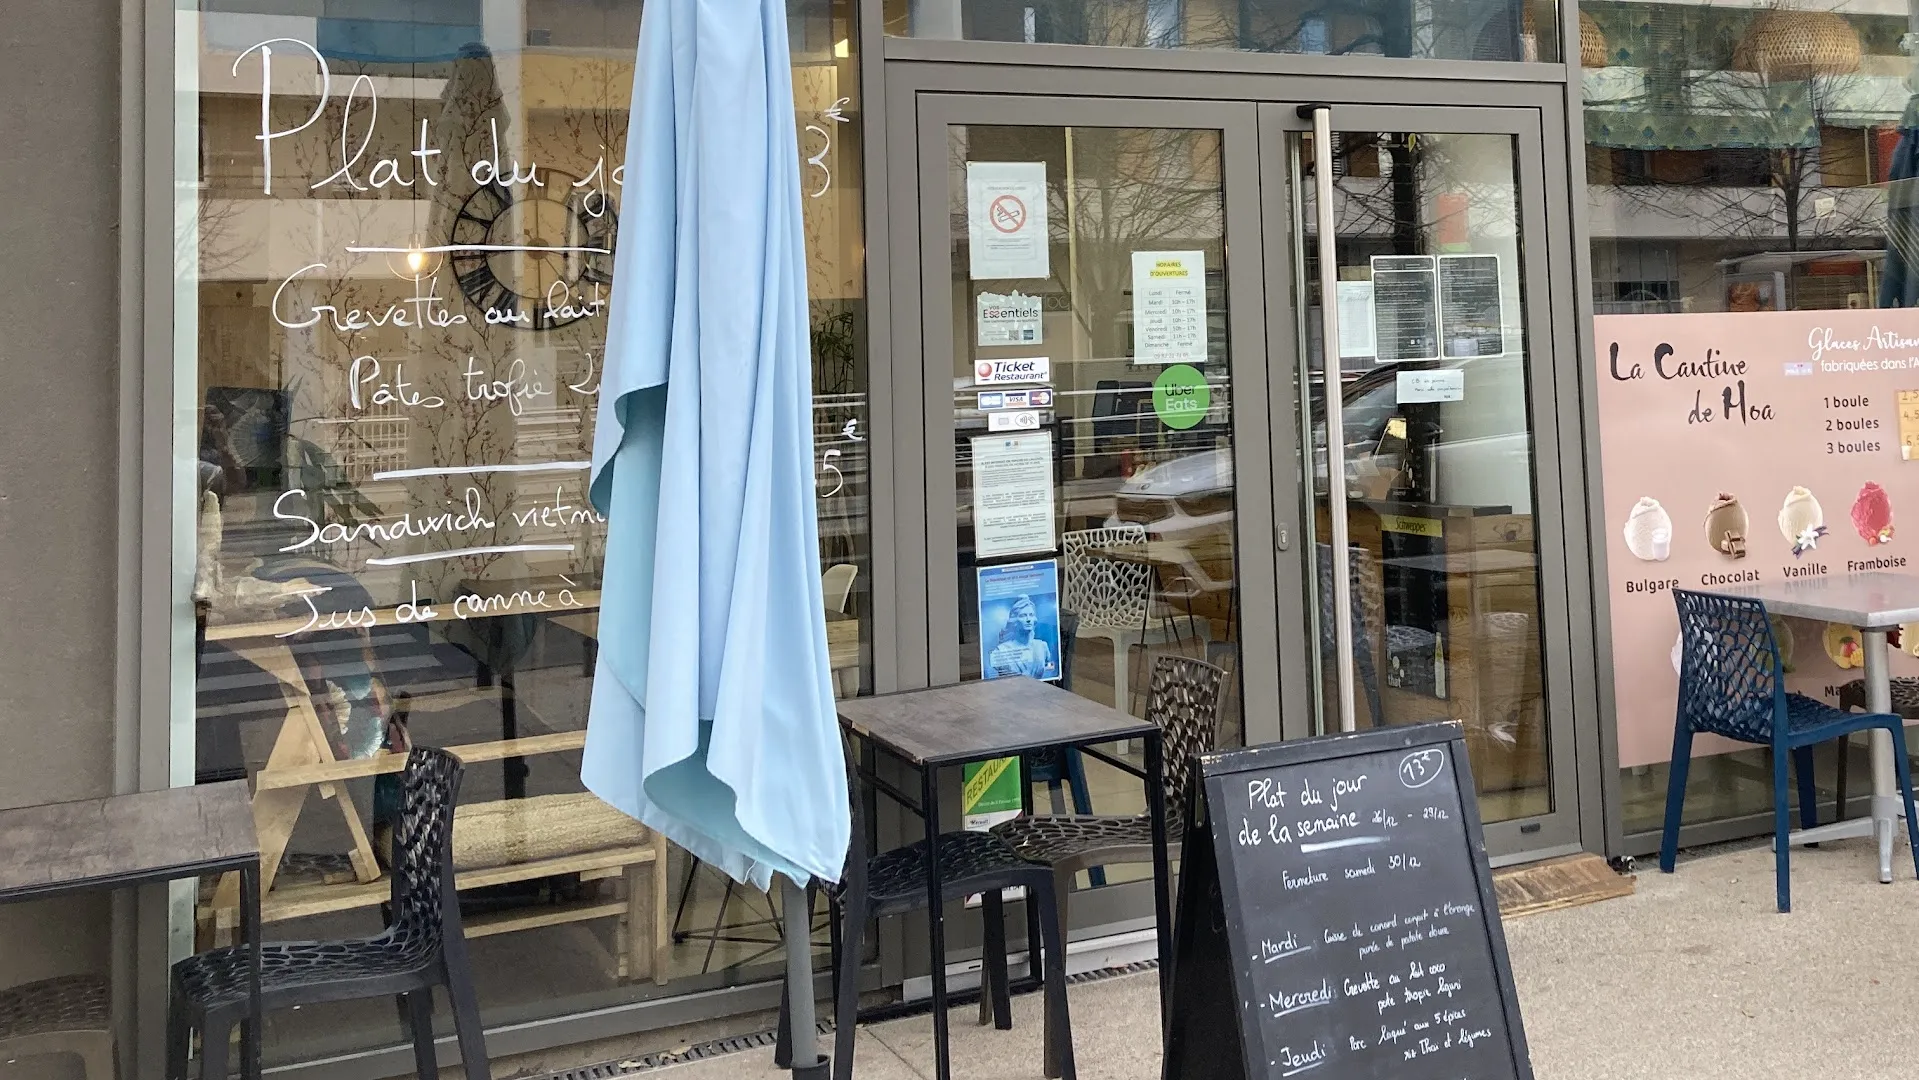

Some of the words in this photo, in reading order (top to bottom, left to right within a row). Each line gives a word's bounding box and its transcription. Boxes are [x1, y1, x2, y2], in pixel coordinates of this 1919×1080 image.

[233, 38, 442, 195] Plat
[471, 117, 544, 187] du
[272, 263, 467, 331] Crevettes
[484, 307, 531, 324] au
[543, 280, 606, 319] lait
[983, 308, 1039, 319] Essentiels
[1808, 327, 1860, 361] Glaces
[994, 361, 1035, 373] Ticket
[1609, 341, 1645, 381] La
[1653, 342, 1750, 381] Cantine
[1821, 359, 1879, 373] fabriquées
[1881, 358, 1907, 370] dans
[349, 356, 444, 408] Pâtes
[1165, 384, 1195, 396] Uber
[1165, 398, 1198, 411] Eats
[1688, 389, 1715, 424] de
[1823, 396, 1830, 409] 1
[1832, 395, 1869, 408] boule
[1825, 419, 1833, 432] 2
[1836, 417, 1879, 431] boules
[1826, 442, 1834, 454] 3
[1838, 440, 1881, 453] boules
[272, 487, 496, 552] Sandwich
[1701, 569, 1760, 586] Chocolat
[1783, 562, 1828, 579] Vanille
[1847, 556, 1907, 572] Framboise
[1626, 577, 1680, 594] Bulgare
[271, 587, 376, 638] Jus
[395, 579, 439, 624] de
[559, 574, 584, 608] à
[1248, 778, 1287, 810] Plat
[1301, 778, 1323, 806] du
[1330, 775, 1367, 812] jour
[1238, 817, 1262, 846] de
[1267, 814, 1292, 844] la
[1297, 811, 1361, 837] semaine
[1282, 867, 1328, 890] Fermeture
[1344, 857, 1376, 879] samedi
[1261, 931, 1298, 959] Mardi
[1352, 921, 1363, 938] de
[1385, 934, 1395, 949] de
[1268, 977, 1332, 1012] Mercredi
[1389, 974, 1401, 985] au
[1280, 1039, 1326, 1067] Jeudi
[1413, 1022, 1430, 1031] aux
[1434, 1012, 1441, 1025] 5
